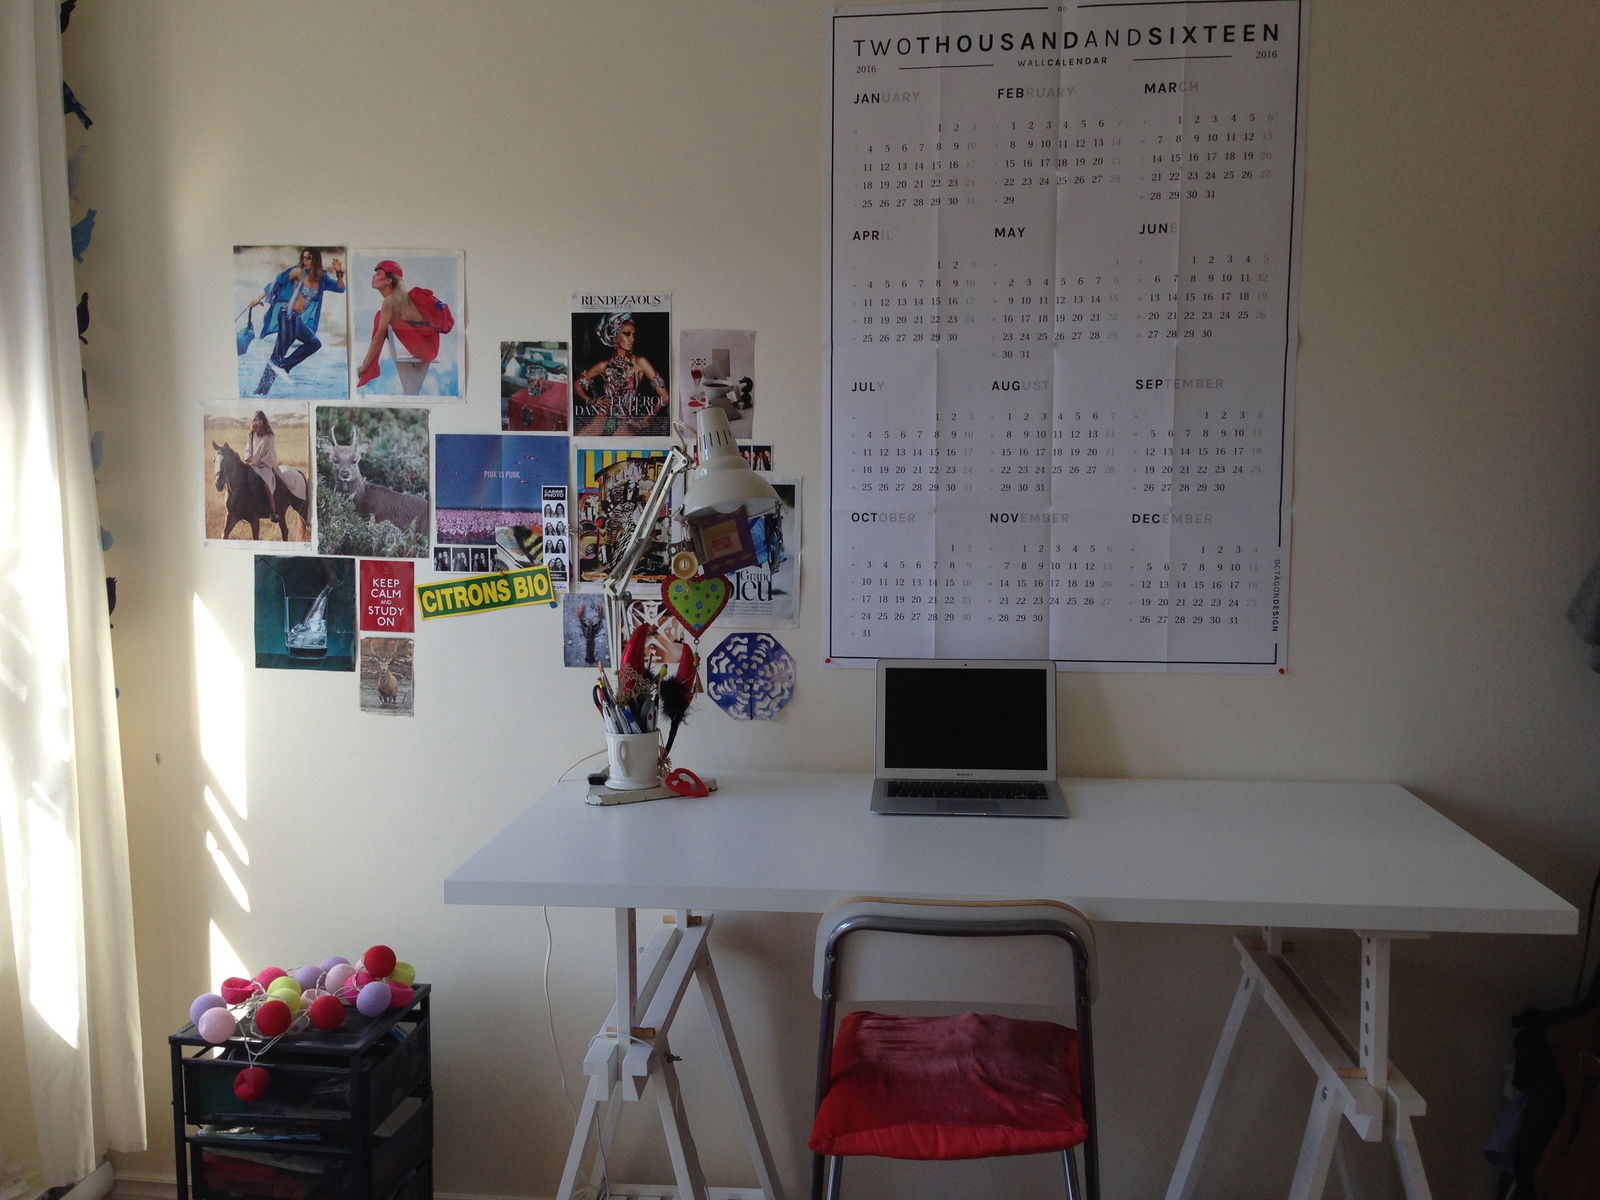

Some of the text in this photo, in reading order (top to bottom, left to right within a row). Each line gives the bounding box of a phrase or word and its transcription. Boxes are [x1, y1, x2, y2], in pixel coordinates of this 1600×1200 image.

[852, 24, 1280, 57] TWOTHOUSANDANDSIXTEEN
[1255, 50, 1278, 60] 2016
[1017, 56, 1108, 68] WALLCALENDAR
[856, 64, 876, 74] 2016
[997, 86, 1076, 100] FEBRUARY
[1144, 81, 1200, 95] MARCH
[853, 91, 921, 105] JANUARY
[1040, 140, 1052, 148] 10
[1056, 140, 1068, 148] 11
[1076, 138, 1088, 148] 12
[1094, 138, 1104, 148] 13
[1152, 152, 1254, 164] 14 15 16 17 18 19
[864, 160, 960, 172] 11 12 13 14 15 16
[1004, 174, 1104, 186] 22 23 24 25 26 27
[1150, 190, 1216, 200] 28 29 30 31
[862, 198, 958, 208] 25 26 27 28 29 30
[994, 226, 1026, 239] MAY
[1139, 222, 1178, 236] JUNE
[852, 230, 893, 242] APRIL
[581, 295, 661, 305] RENDEZ-VOUS
[1022, 296, 1032, 304] 10
[1040, 296, 1048, 304] 11
[1054, 296, 1066, 304] 12
[1074, 296, 1086, 304] 13
[1090, 296, 1100, 304] 14
[864, 316, 958, 324] 18 19 20 21 22 23
[1148, 310, 1248, 320] 20 21 22 23 24 25
[1002, 332, 1100, 342] 23 24 25 26 27 28
[851, 382, 886, 392] JULY
[992, 380, 1050, 392] AUGUST
[1135, 378, 1224, 390] SEPTEMBER
[575, 406, 607, 416] DANS
[864, 448, 956, 456] 11 12 13 14 15 16
[1144, 446, 1244, 456] 12 13 14 15 16 17
[1000, 466, 1098, 474] 22 23 24 25 26 27
[862, 482, 956, 492] 25 26 27 28 29 30
[1144, 484, 1226, 492] 26 27 28 29 30
[851, 512, 916, 523] OCTOBER
[990, 512, 1070, 524] NOVEMBER
[1132, 512, 1212, 525] DECEMBER
[740, 569, 772, 582] Grand
[372, 578, 400, 588] KEEP
[1000, 580, 1094, 588] 14 15 16 17 18 19
[370, 588, 402, 599] CALM
[421, 572, 548, 610] CITRONS BIO
[1272, 558, 1281, 632] OCTAGONDESIGN
[1140, 598, 1238, 608] 19 20 21 22 23 24
[368, 606, 404, 617] STUDY
[378, 616, 394, 626] ON
[860, 612, 954, 622] 24 25 26 27 28 29
[998, 614, 1044, 622] 28 29 30
